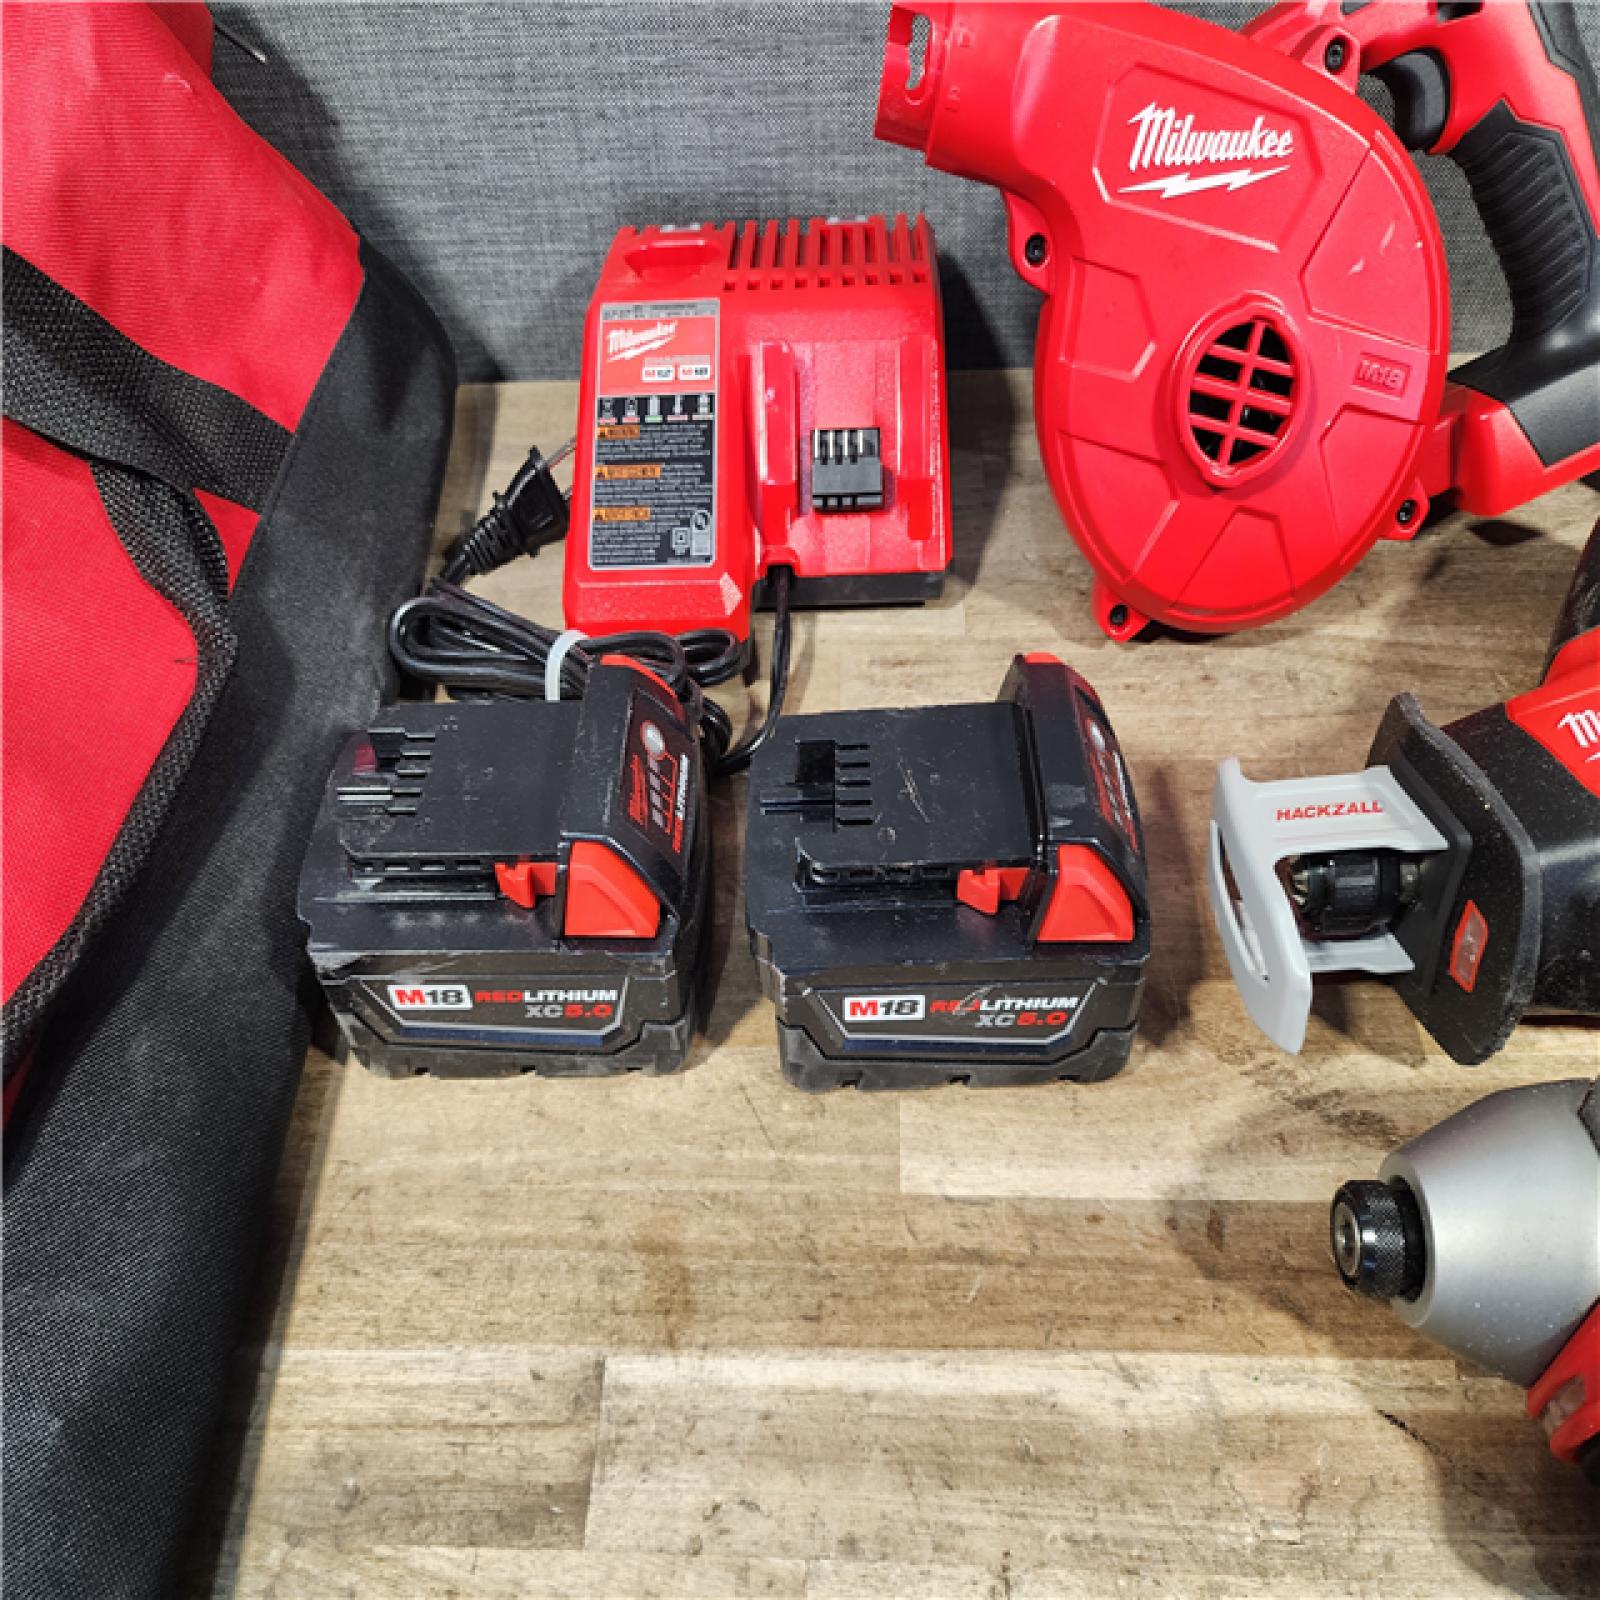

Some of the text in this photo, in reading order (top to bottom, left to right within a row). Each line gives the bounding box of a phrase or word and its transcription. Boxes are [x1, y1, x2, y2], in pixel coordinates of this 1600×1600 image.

[1127, 102, 1294, 173] Milwaukee
[1276, 800, 1383, 821] HACKZALL
[394, 989, 618, 1005] M18 REDLITHIUM
[849, 999, 922, 1016] M18
